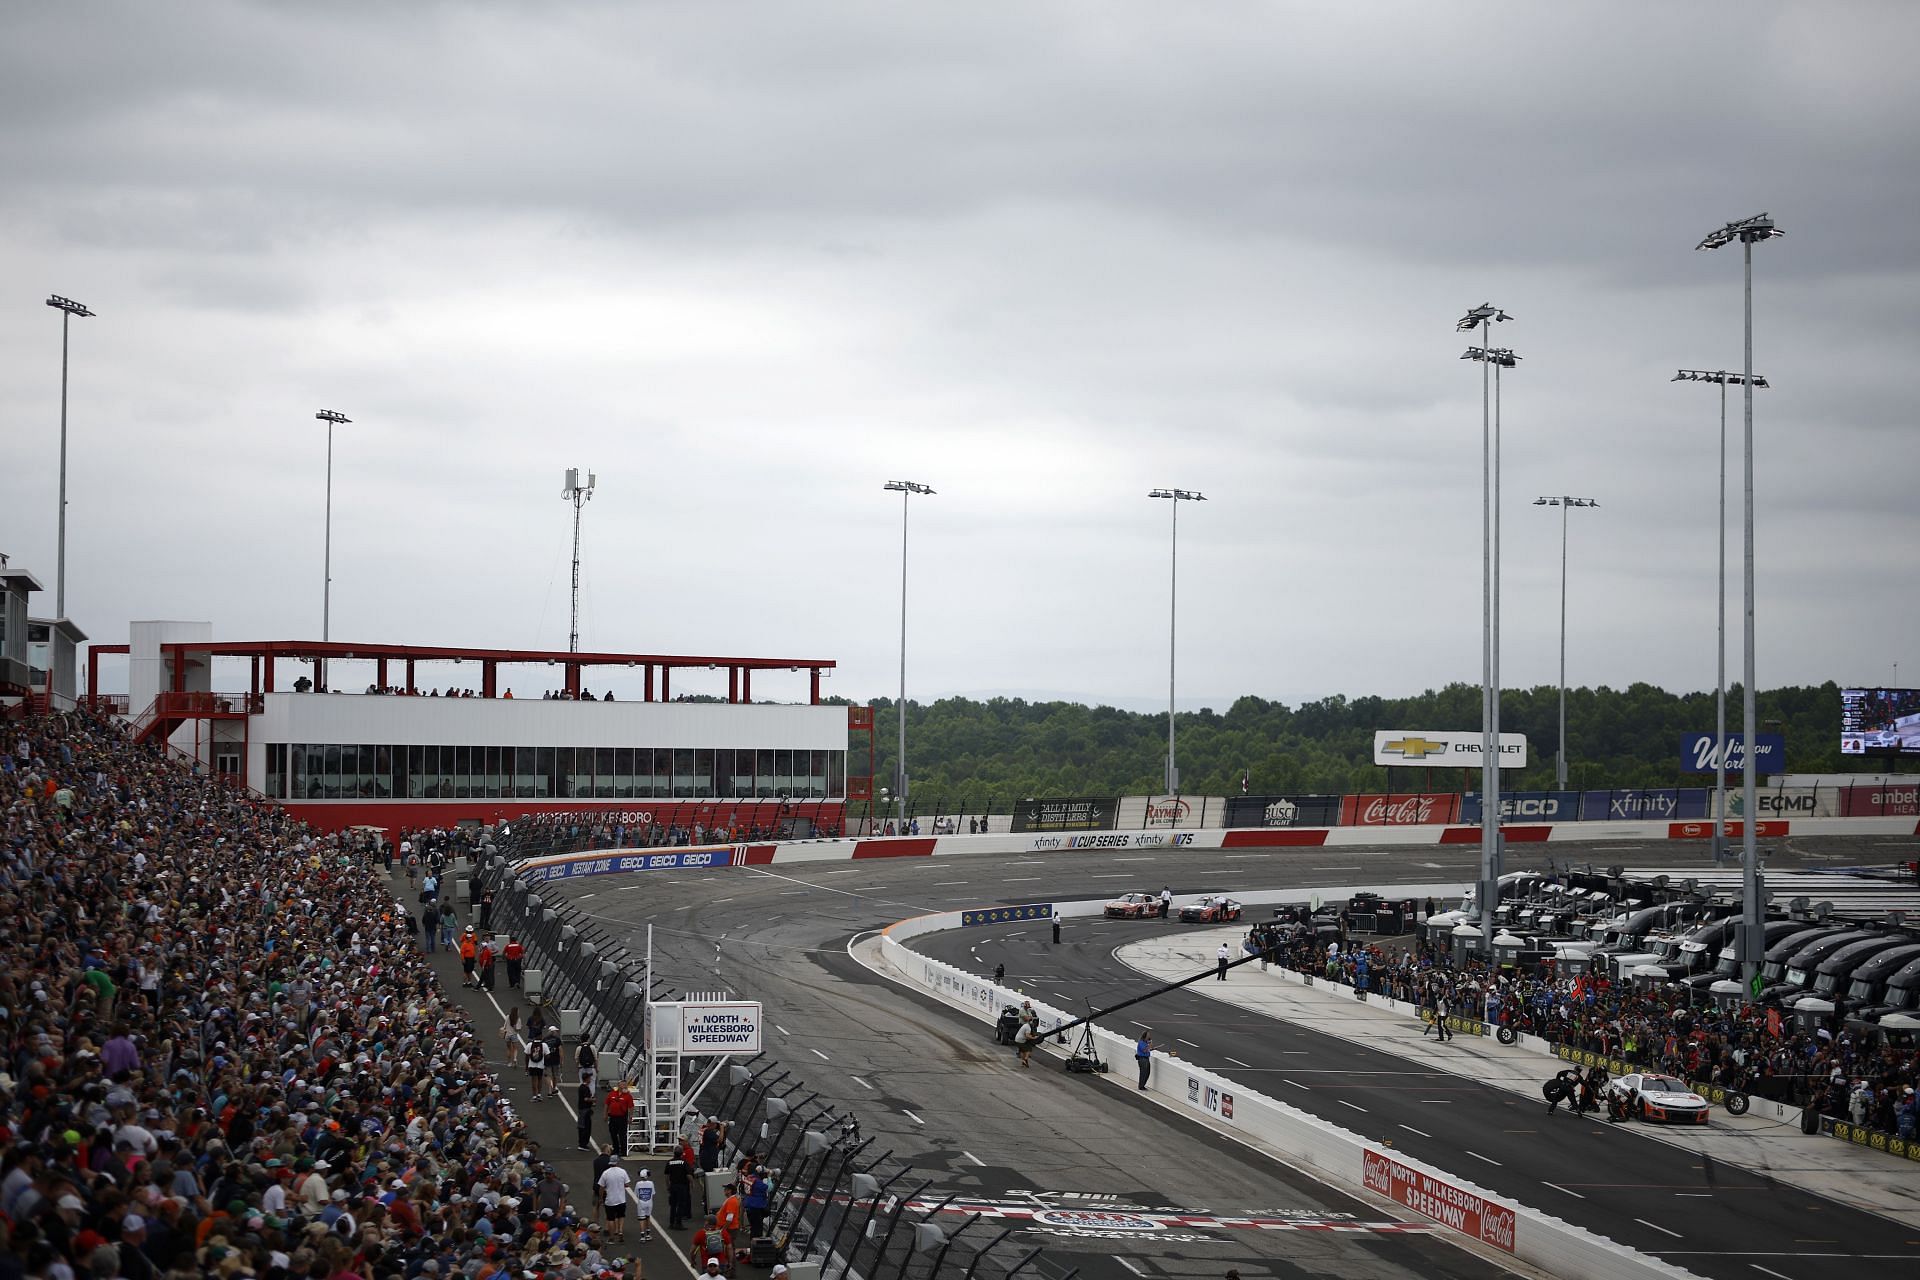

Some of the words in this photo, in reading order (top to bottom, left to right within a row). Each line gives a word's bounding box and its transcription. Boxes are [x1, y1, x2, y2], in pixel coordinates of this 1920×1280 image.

[1455, 744, 1522, 753] CHEVLET
[1147, 804, 1182, 818] RAYMER
[1498, 799, 1559, 816] EICO
[1611, 793, 1678, 817] xfinity
[1759, 796, 1817, 811] ECMD
[1264, 806, 1299, 820] BUSCH
[1034, 836, 1061, 849] xfinity
[1077, 835, 1097, 848] CUP
[1096, 835, 1130, 847] SERIES
[1135, 833, 1164, 847] xfinity
[1181, 833, 1195, 845] 75
[620, 856, 645, 869] GEICO
[649, 854, 677, 867] GEICO
[682, 853, 712, 865] GEICO
[703, 1015, 739, 1024] NORTH
[688, 1024, 755, 1034] WILKESBORO
[691, 1034, 750, 1043] SPEEDWAY
[1391, 1164, 1416, 1185] NORTH
[1423, 1176, 1481, 1215] WILKESBORO
[1406, 1187, 1466, 1230] SPEEDWAY
